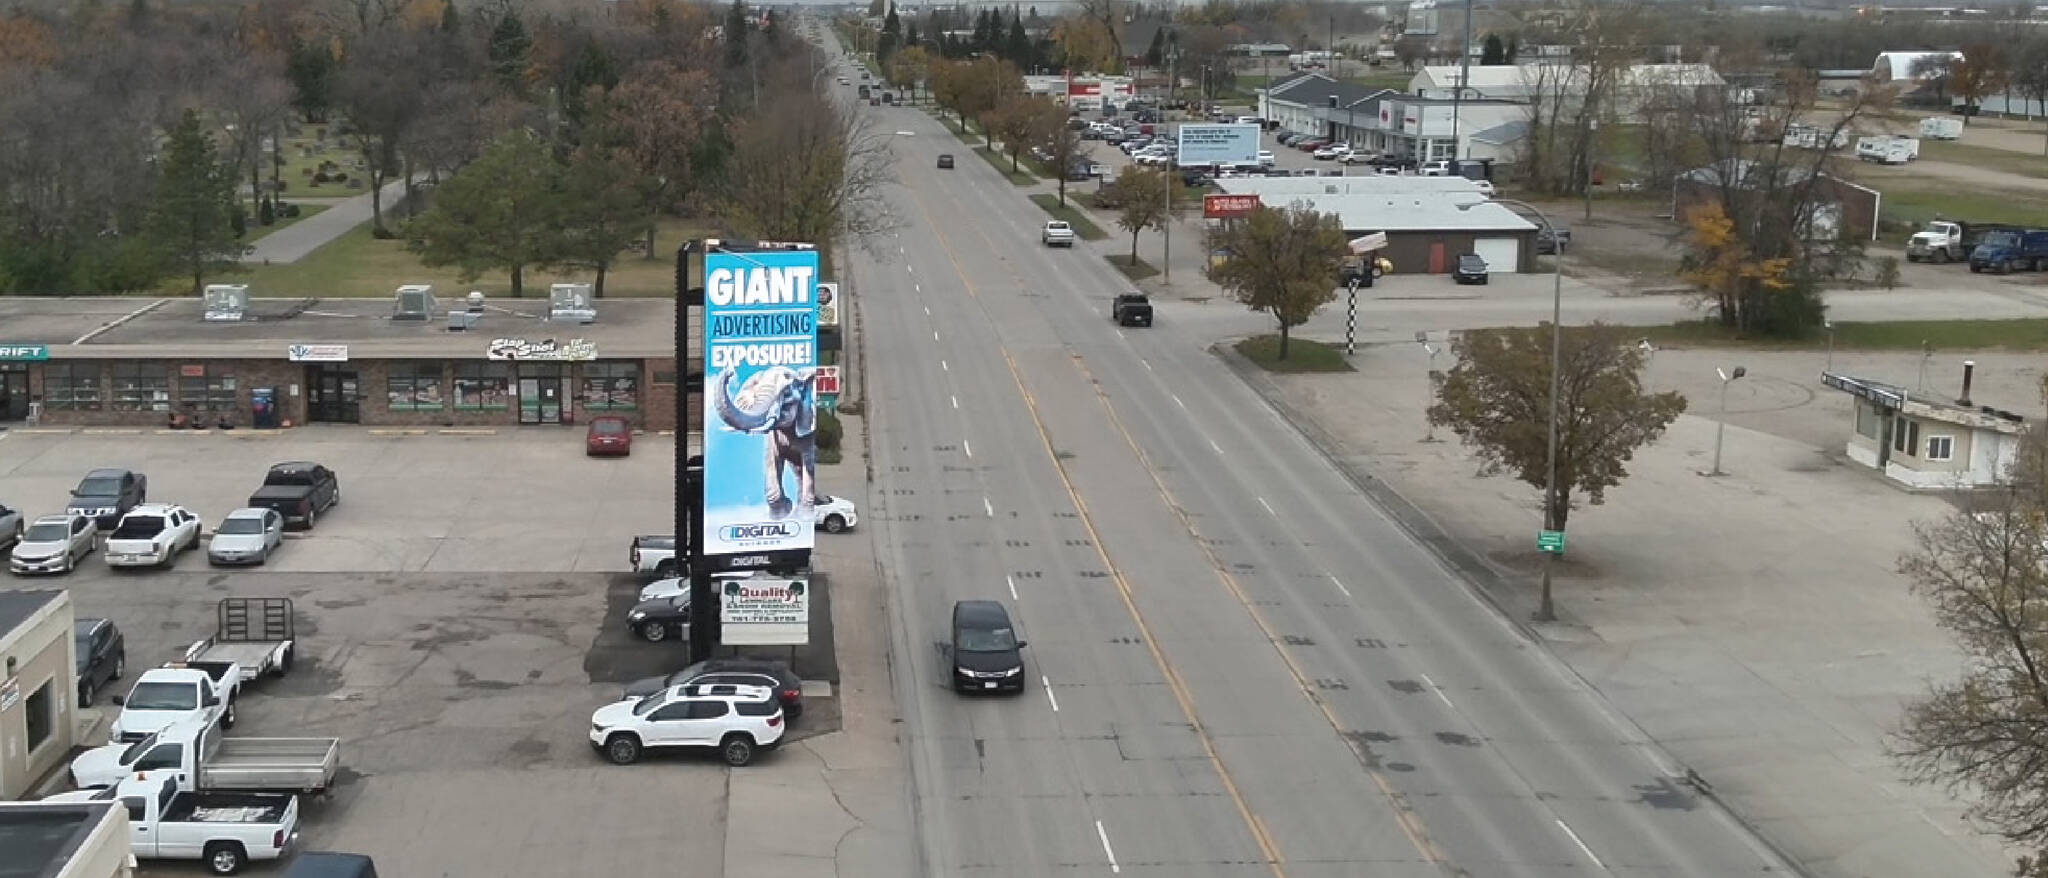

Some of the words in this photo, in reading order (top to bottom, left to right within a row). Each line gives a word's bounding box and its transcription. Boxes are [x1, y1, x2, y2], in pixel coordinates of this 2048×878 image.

[708, 266, 813, 305] GIANT
[713, 313, 811, 336] ADVERTISING
[711, 342, 811, 367] EXPOSURE!
[740, 587, 794, 602] Quality
